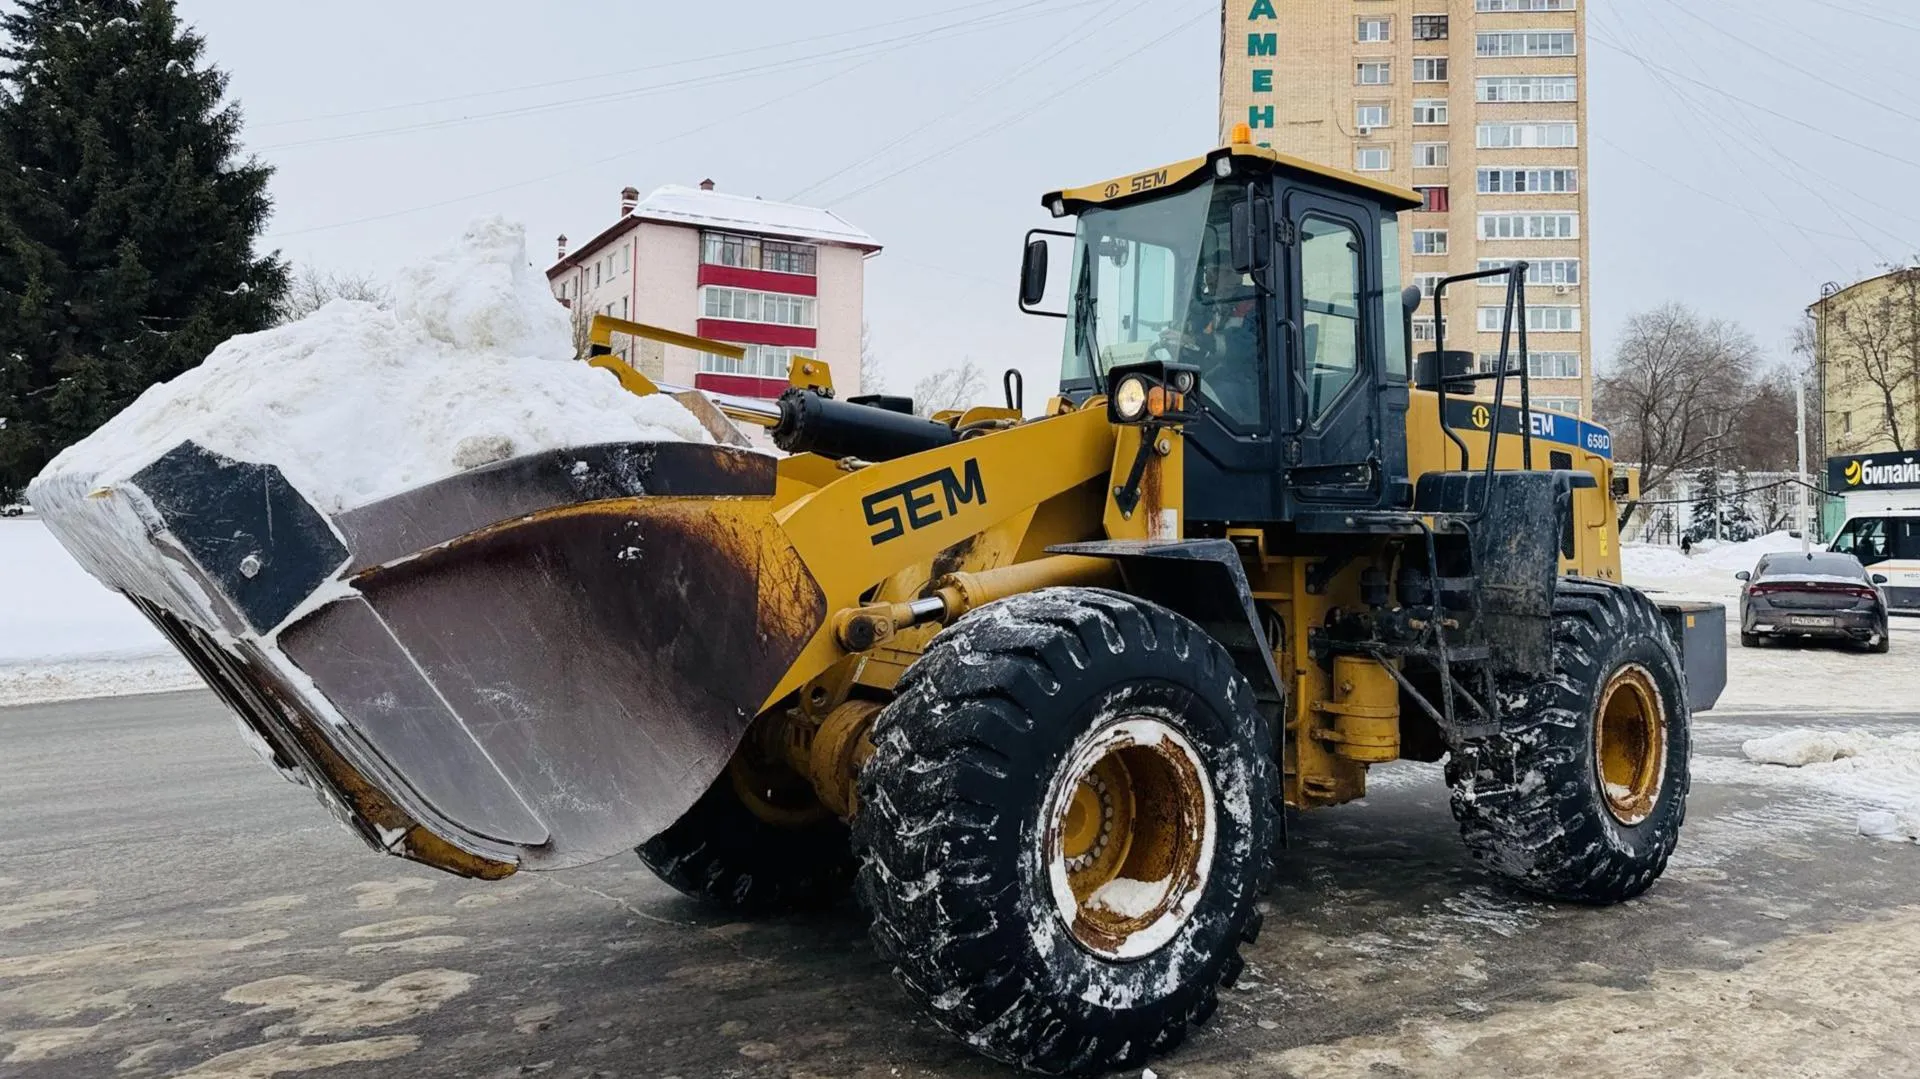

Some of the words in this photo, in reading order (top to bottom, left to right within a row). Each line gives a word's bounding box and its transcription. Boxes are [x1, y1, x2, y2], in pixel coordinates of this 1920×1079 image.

[1247, 0, 1277, 148] АМЕН
[1131, 169, 1167, 193] SEM
[1587, 433, 1610, 449] 658D
[861, 457, 987, 546] SEM
